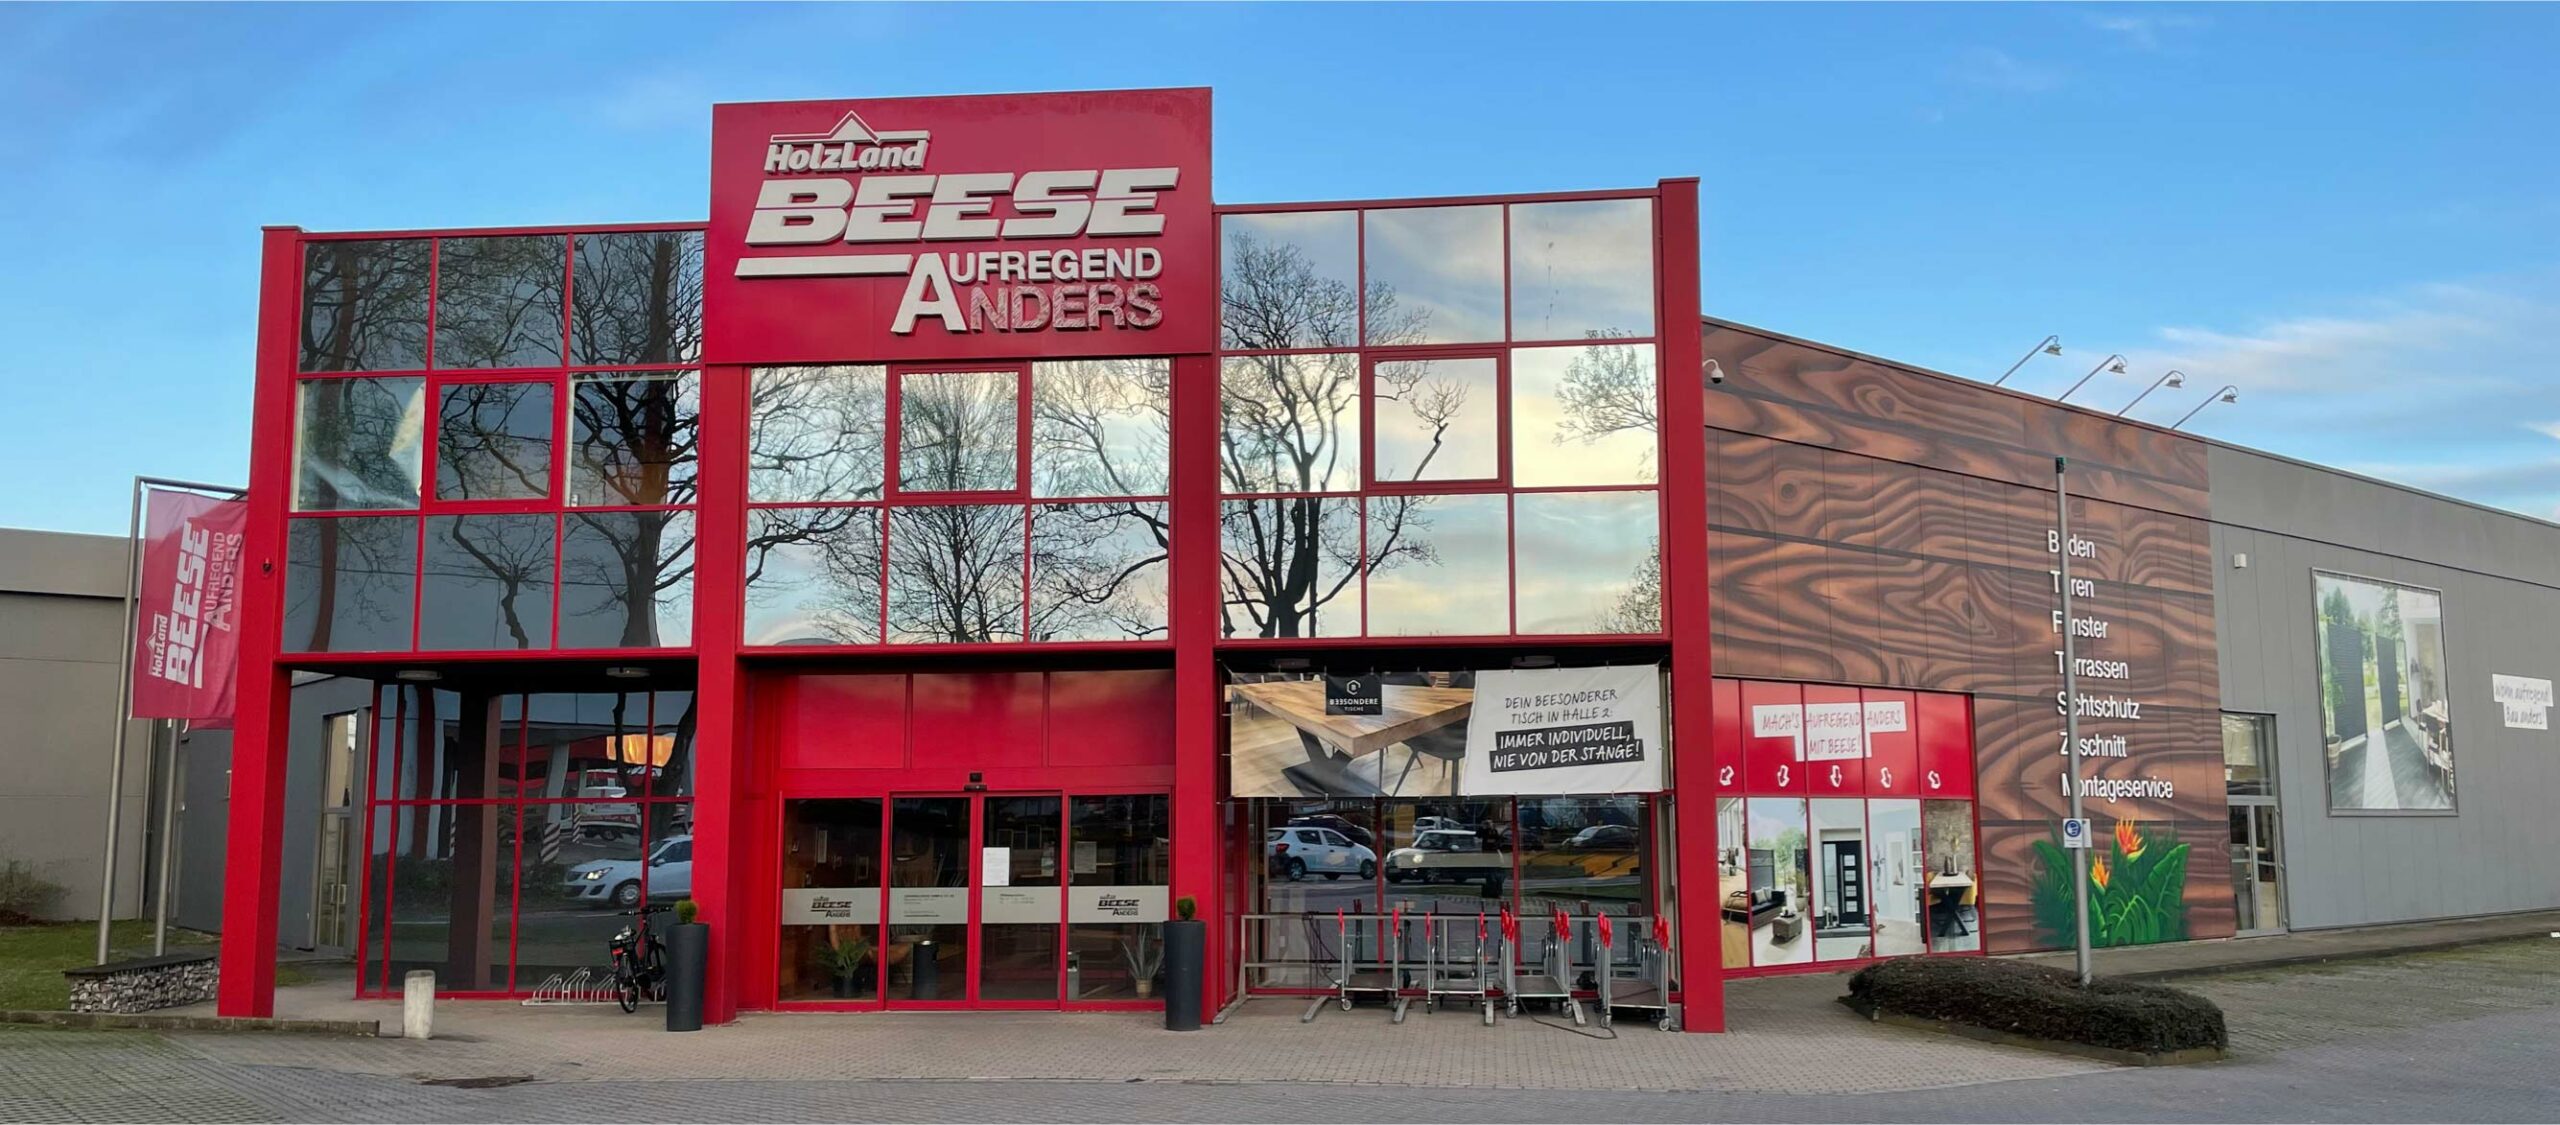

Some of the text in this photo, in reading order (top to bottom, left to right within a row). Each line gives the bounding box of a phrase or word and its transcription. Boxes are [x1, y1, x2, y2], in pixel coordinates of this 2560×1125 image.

[763, 138, 928, 173] HolzLand
[744, 166, 1181, 246] BEESE
[890, 250, 1164, 334] ANDERS
[2047, 529, 2096, 559] Bden
[2049, 569, 2095, 598] Tren
[165, 519, 210, 686] BEESE
[2051, 610, 2109, 639] Fnster
[151, 613, 168, 678] HolzLand
[2054, 650, 2129, 680] Trrassen
[1505, 688, 1618, 710] DEIN BEESONDERER
[2057, 690, 2141, 719] Schtschutz
[1511, 711, 1543, 725] TISCH
[1547, 710, 1560, 723] IN
[1562, 707, 1599, 722] HALLE
[1806, 711, 1862, 730] AUFREGEND
[1867, 709, 1901, 728] ANDERS
[1499, 725, 1631, 750] IMMER INDIVIDUELL,
[1809, 735, 1861, 755] MIT BEESE!
[2060, 731, 2128, 758] Zschnitt
[1493, 741, 1640, 769] NIE VON DER STANGE!
